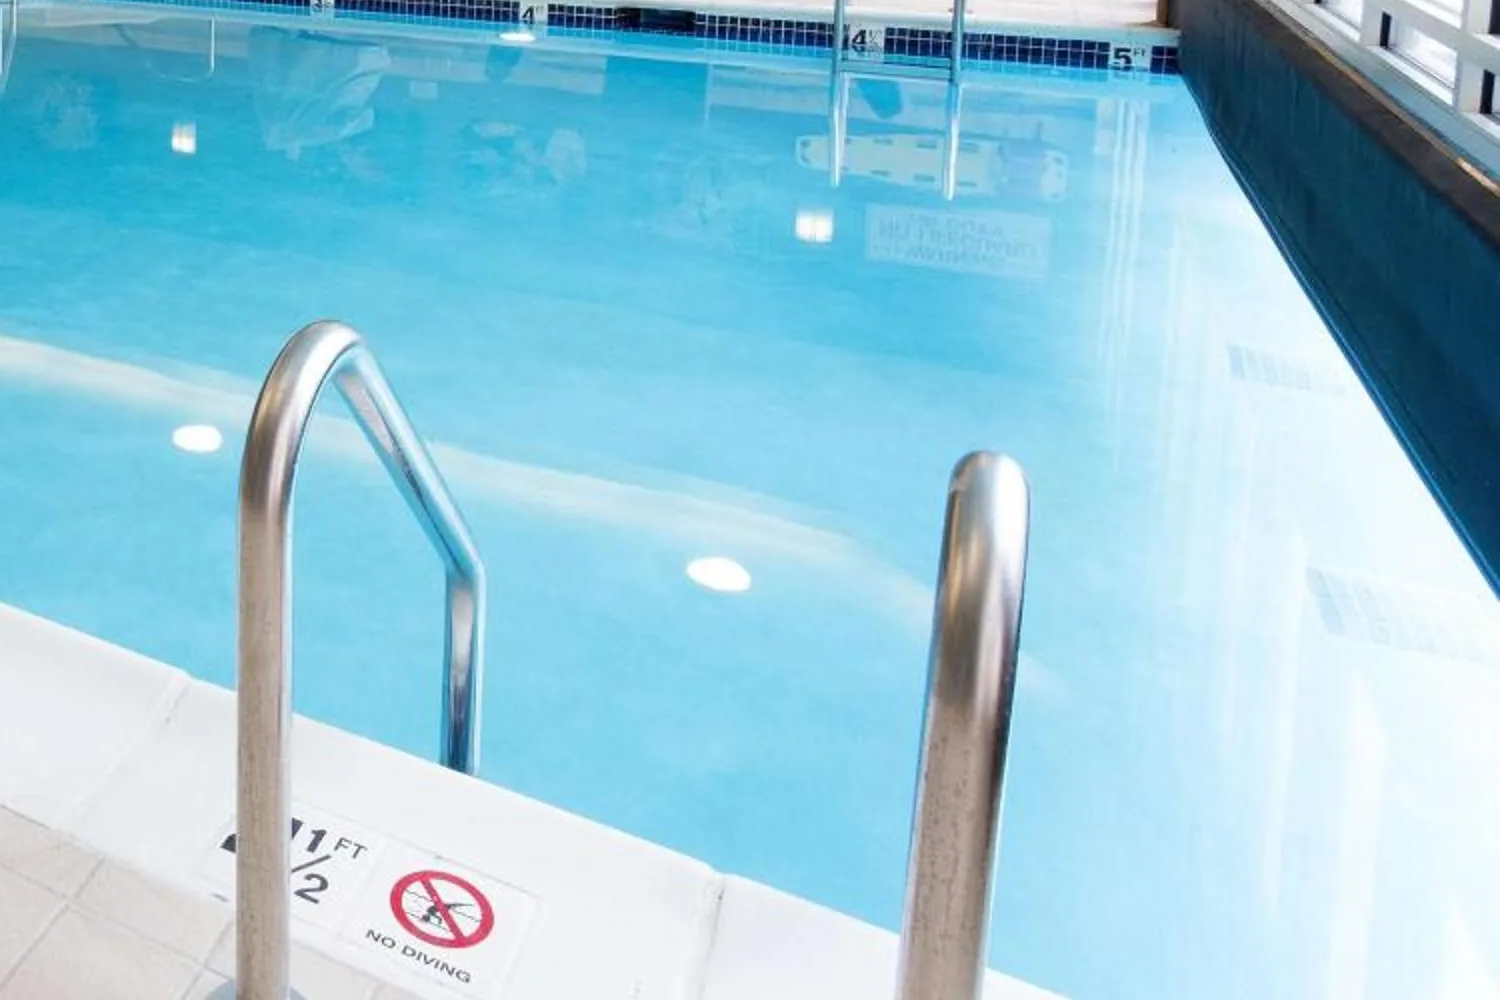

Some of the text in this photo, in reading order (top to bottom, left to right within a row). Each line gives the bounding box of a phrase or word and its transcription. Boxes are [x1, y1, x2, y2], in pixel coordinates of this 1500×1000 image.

[1114, 48, 1133, 70] 5
[334, 837, 368, 859] FT
[365, 929, 472, 984] NO DIVING
